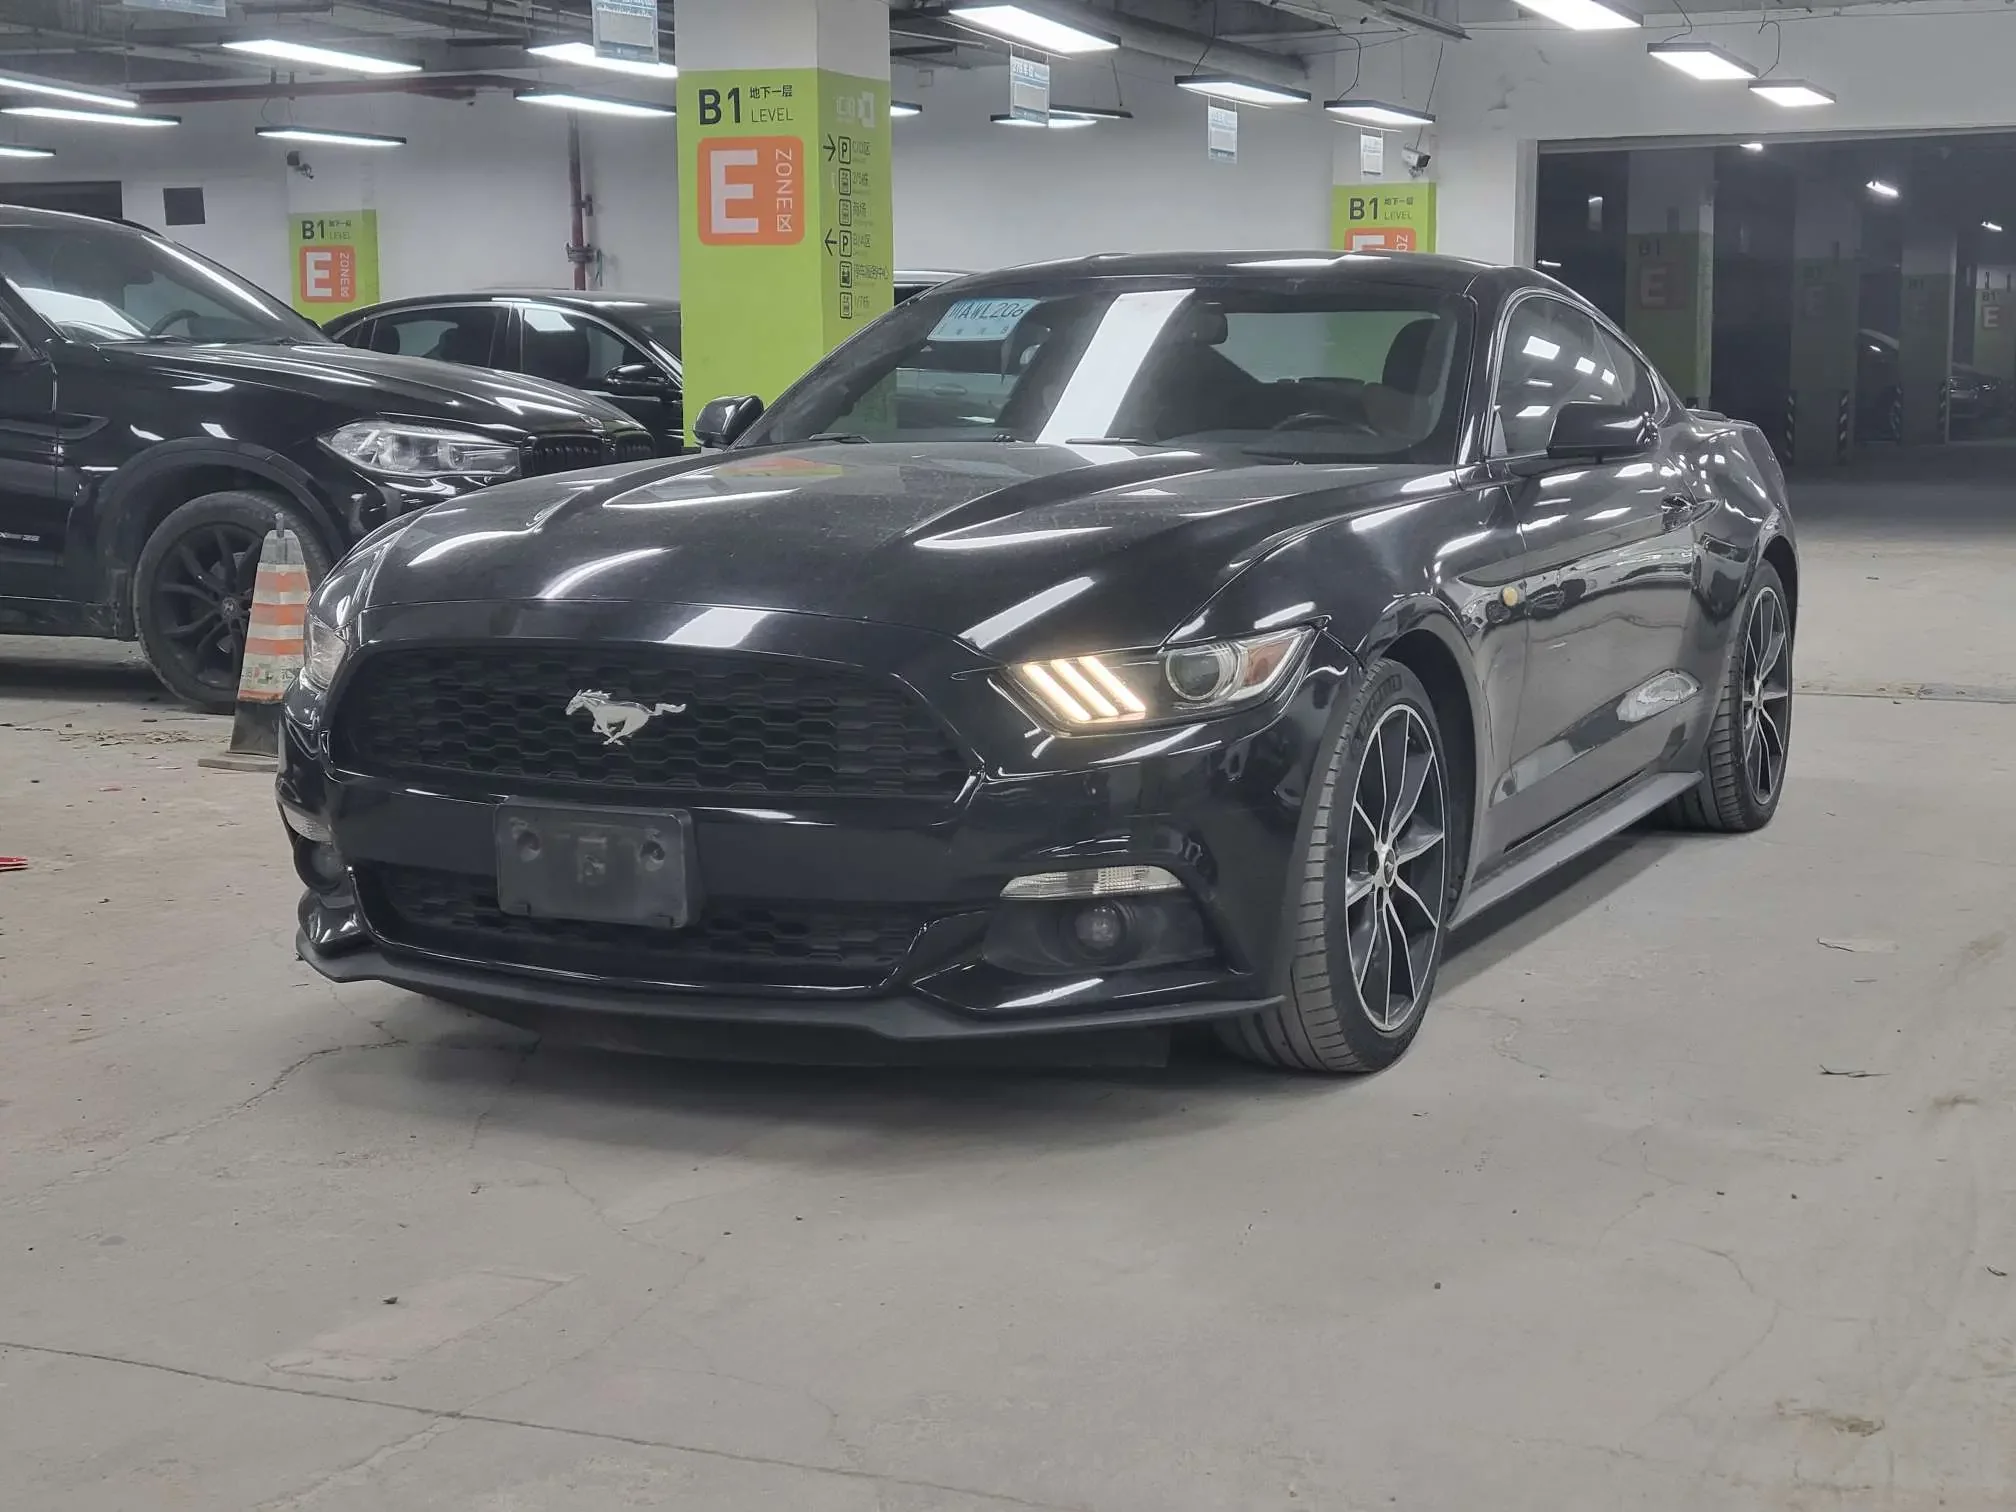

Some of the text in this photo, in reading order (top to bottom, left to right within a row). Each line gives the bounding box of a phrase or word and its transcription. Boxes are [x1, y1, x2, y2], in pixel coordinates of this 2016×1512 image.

[749, 84, 793, 99] 地下一层
[698, 87, 741, 125] B1
[751, 107, 794, 122] LEVEL
[710, 149, 759, 234] E
[1349, 197, 1378, 220] B1
[302, 219, 325, 239] B1
[306, 251, 332, 297] E
[1983, 306, 2000, 328] E
